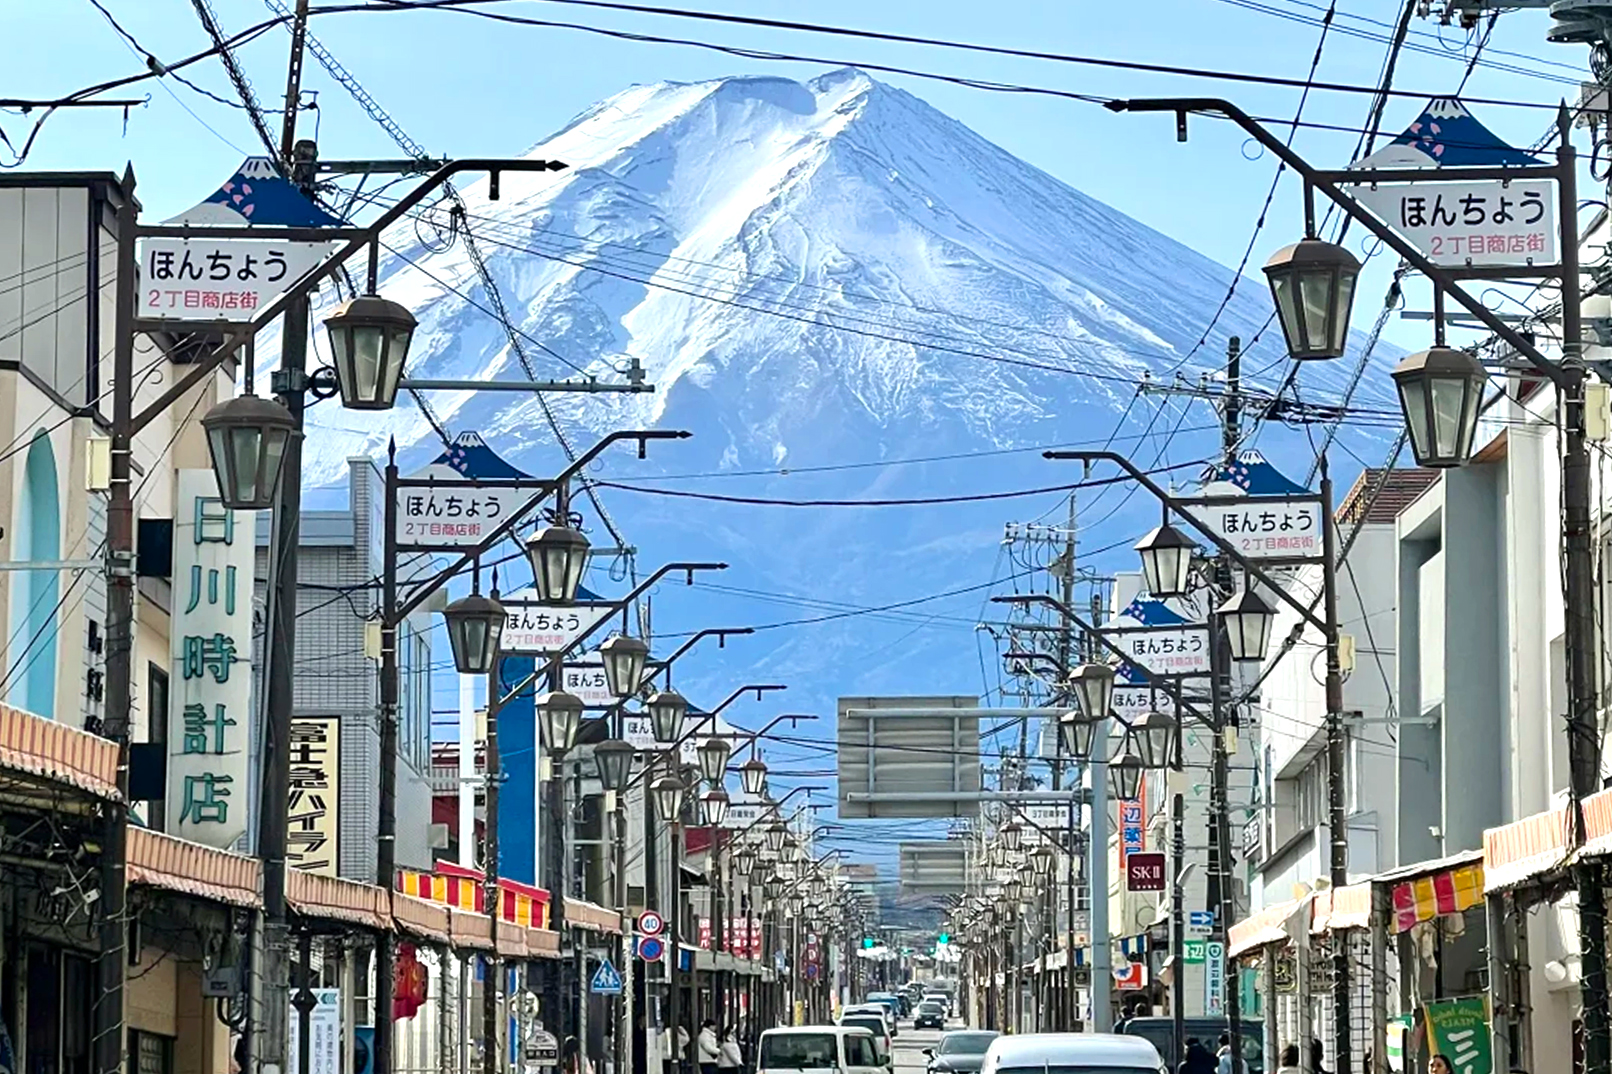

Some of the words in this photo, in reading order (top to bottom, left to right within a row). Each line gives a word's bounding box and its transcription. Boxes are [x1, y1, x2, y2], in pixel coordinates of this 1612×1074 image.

[1401, 191, 1545, 227] ほんちょう
[1431, 233, 1546, 255] 2丁目商店街
[150, 249, 288, 282] ほんちょう
[148, 290, 259, 310] 2丁目商店街
[406, 495, 501, 518] ほんちょう
[405, 522, 481, 536] 2丁目商店街
[1222, 509, 1313, 534] ほんちょう
[1241, 535, 1314, 551] 2丁目商店街
[506, 612, 581, 632] ほんちょう
[1132, 635, 1202, 656] ほんちょう
[180, 495, 238, 825] 日川時計店
[1124, 799, 1142, 854] 辺薬
[644, 918, 658, 929] 40
